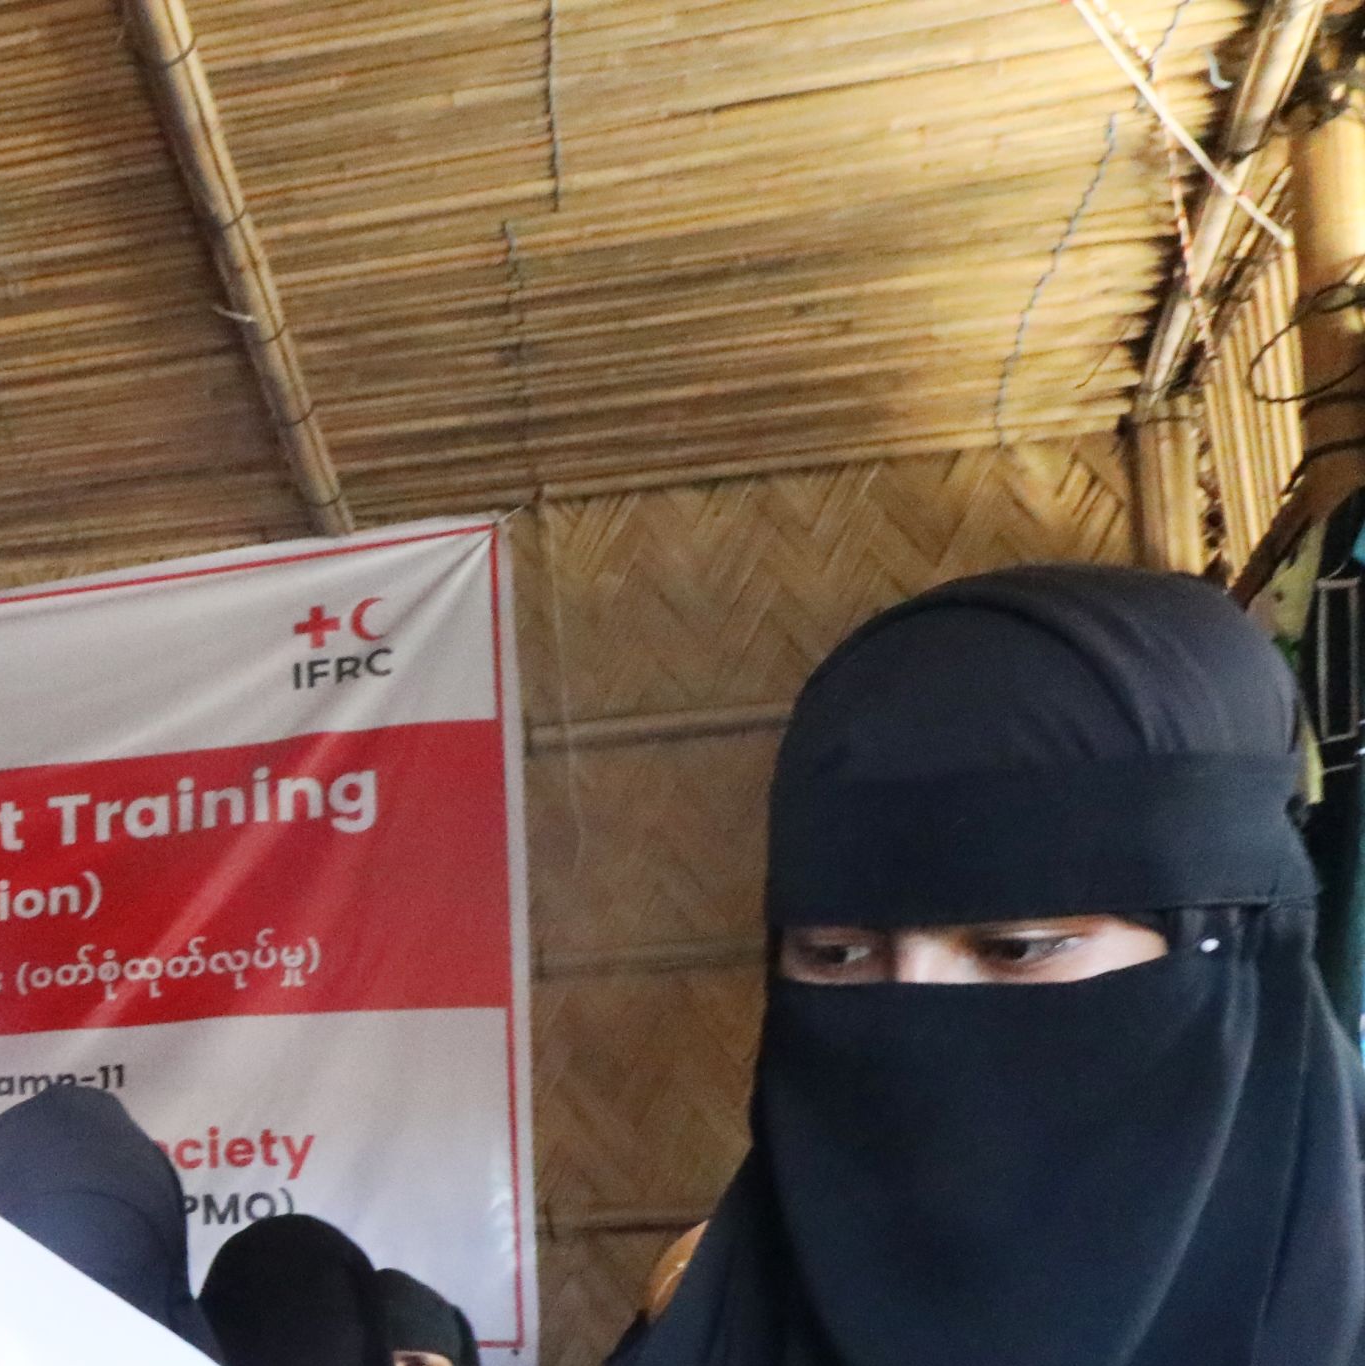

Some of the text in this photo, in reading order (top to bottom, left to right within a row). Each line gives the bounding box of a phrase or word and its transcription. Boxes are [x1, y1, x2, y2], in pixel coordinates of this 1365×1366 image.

[293, 646, 394, 691] IFRC
[47, 766, 378, 846] Training
[155, 1125, 316, 1181] ciety
[182, 1187, 295, 1226] PMO)
